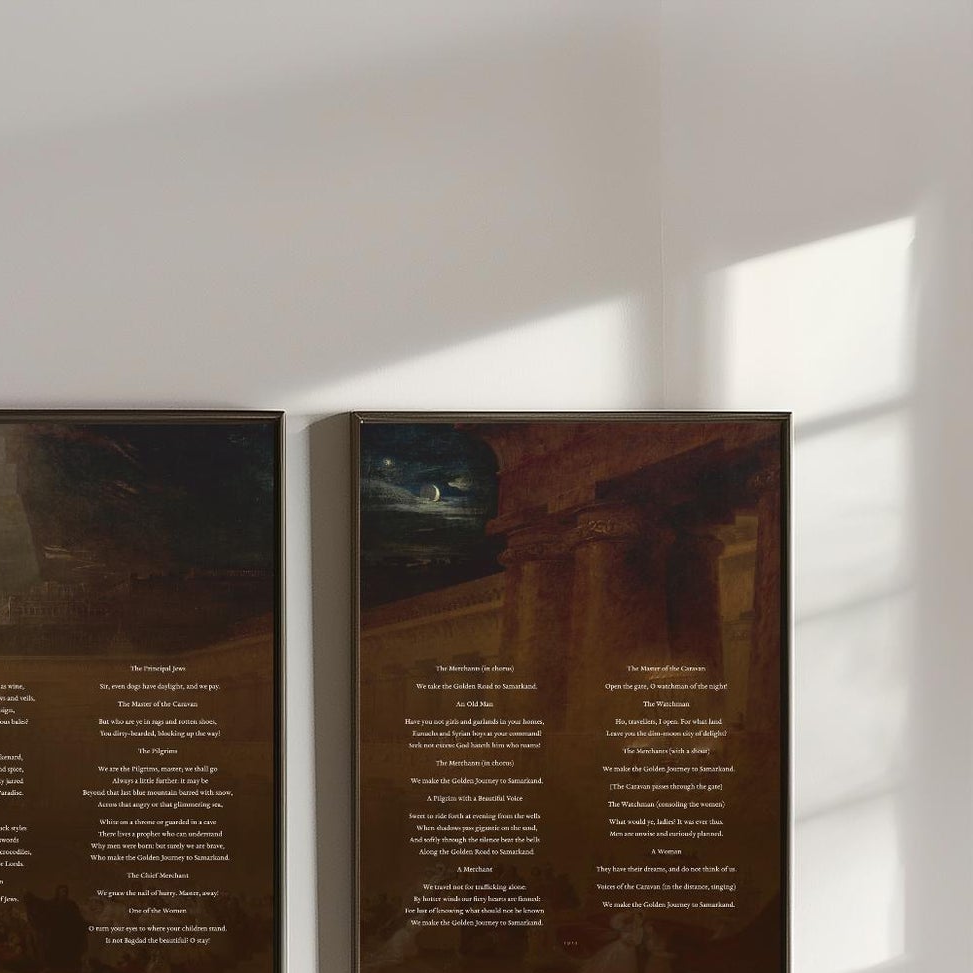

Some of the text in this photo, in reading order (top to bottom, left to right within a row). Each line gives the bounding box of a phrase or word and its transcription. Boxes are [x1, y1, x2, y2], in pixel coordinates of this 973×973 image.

[99, 682, 110, 691] Sir,
[127, 682, 141, 692] dogs
[604, 682, 621, 692] Open
[152, 747, 178, 757] Pilgrims
[670, 782, 695, 792] through
[82, 789, 105, 798] Beyond
[434, 794, 456, 804] Pilgrim
[91, 842, 105, 851] Why
[596, 865, 611, 874] They
